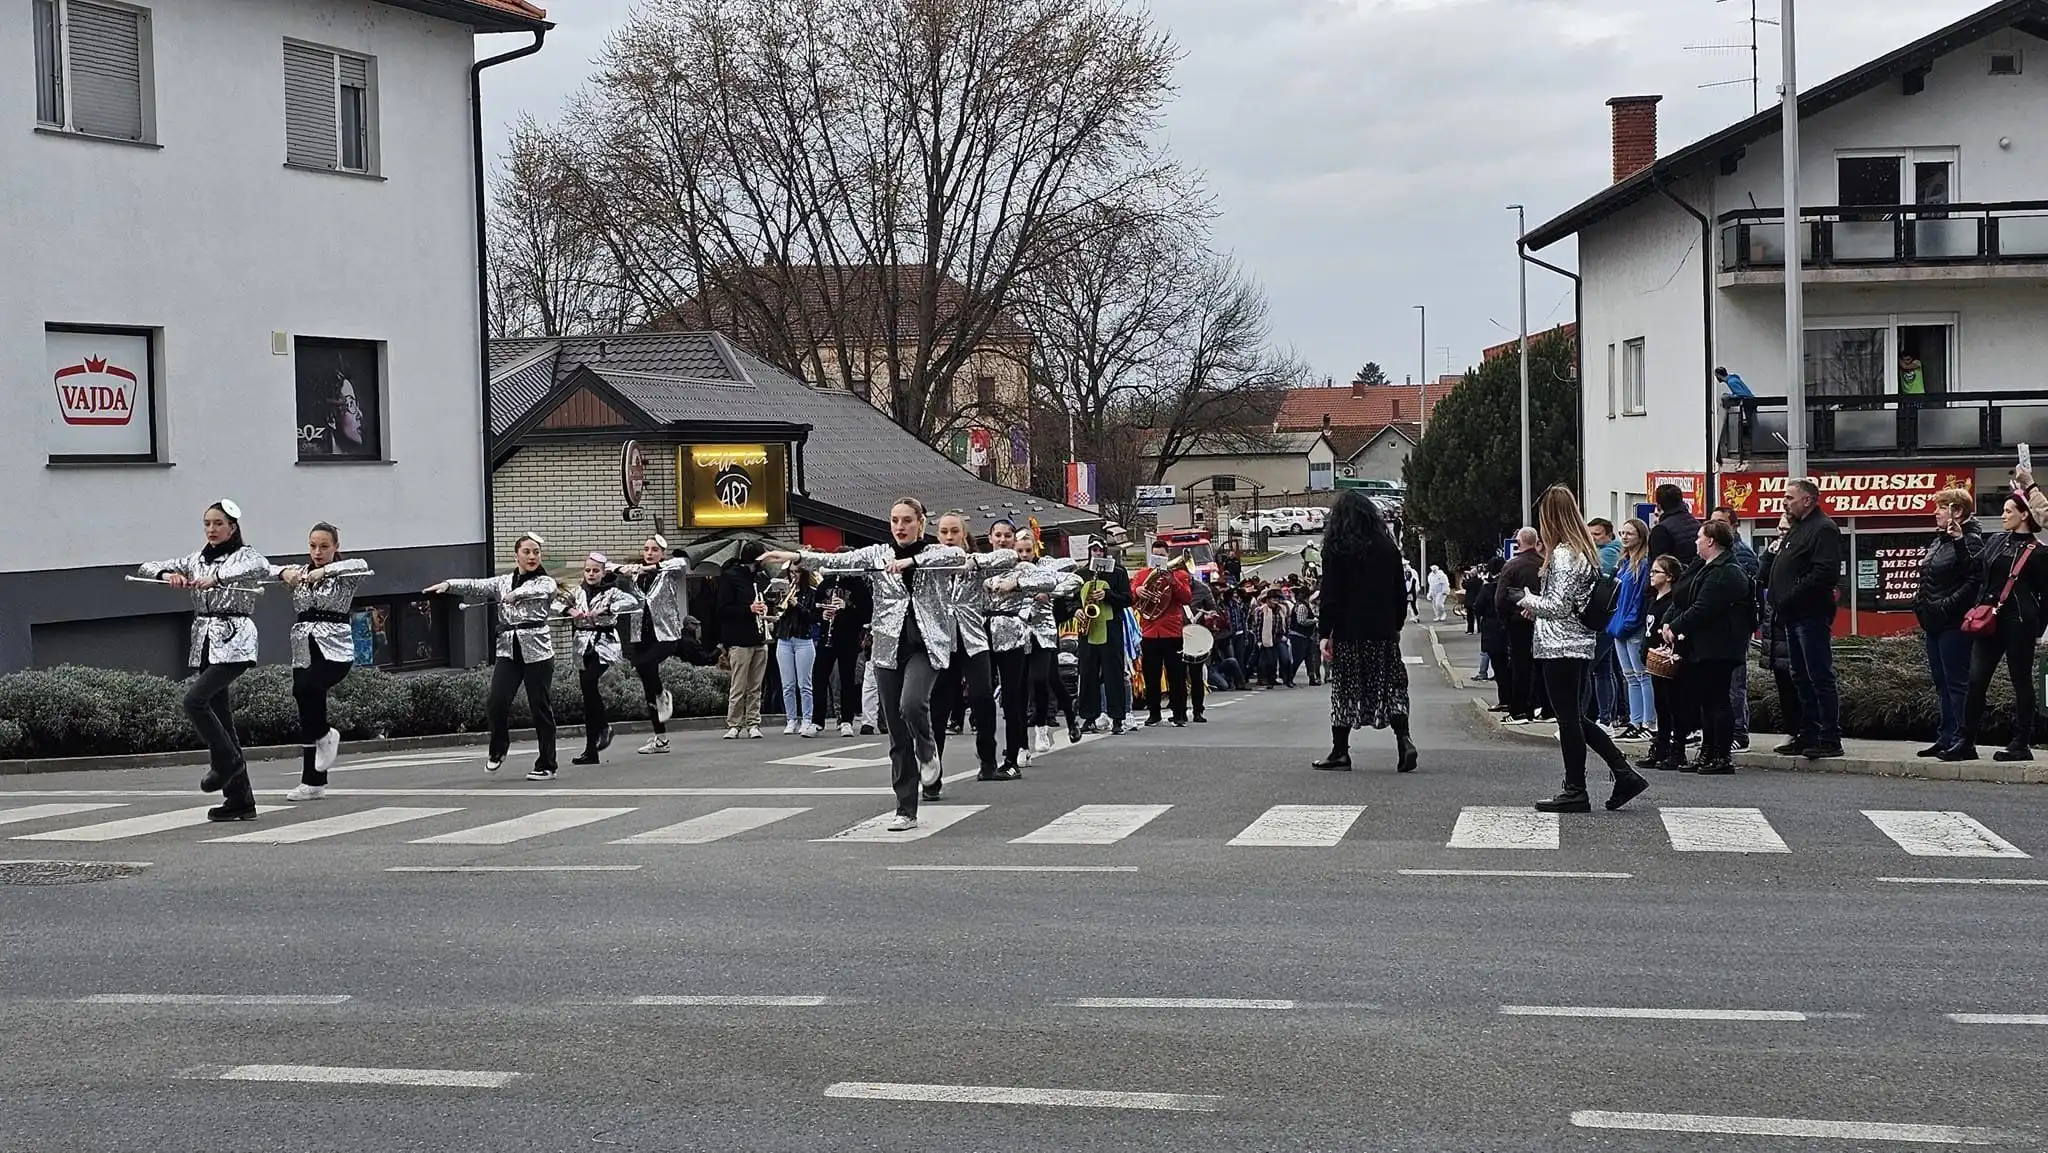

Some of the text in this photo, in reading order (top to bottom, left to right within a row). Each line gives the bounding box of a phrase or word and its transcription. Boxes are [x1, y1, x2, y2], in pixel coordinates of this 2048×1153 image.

[61, 385, 129, 413] VAJDA
[743, 451, 769, 466] bar
[1757, 473, 1938, 493] MIMURSKI
[720, 480, 748, 511] ART
[1875, 547, 1928, 558] SVJEŽ
[1884, 581, 1920, 590] koko
